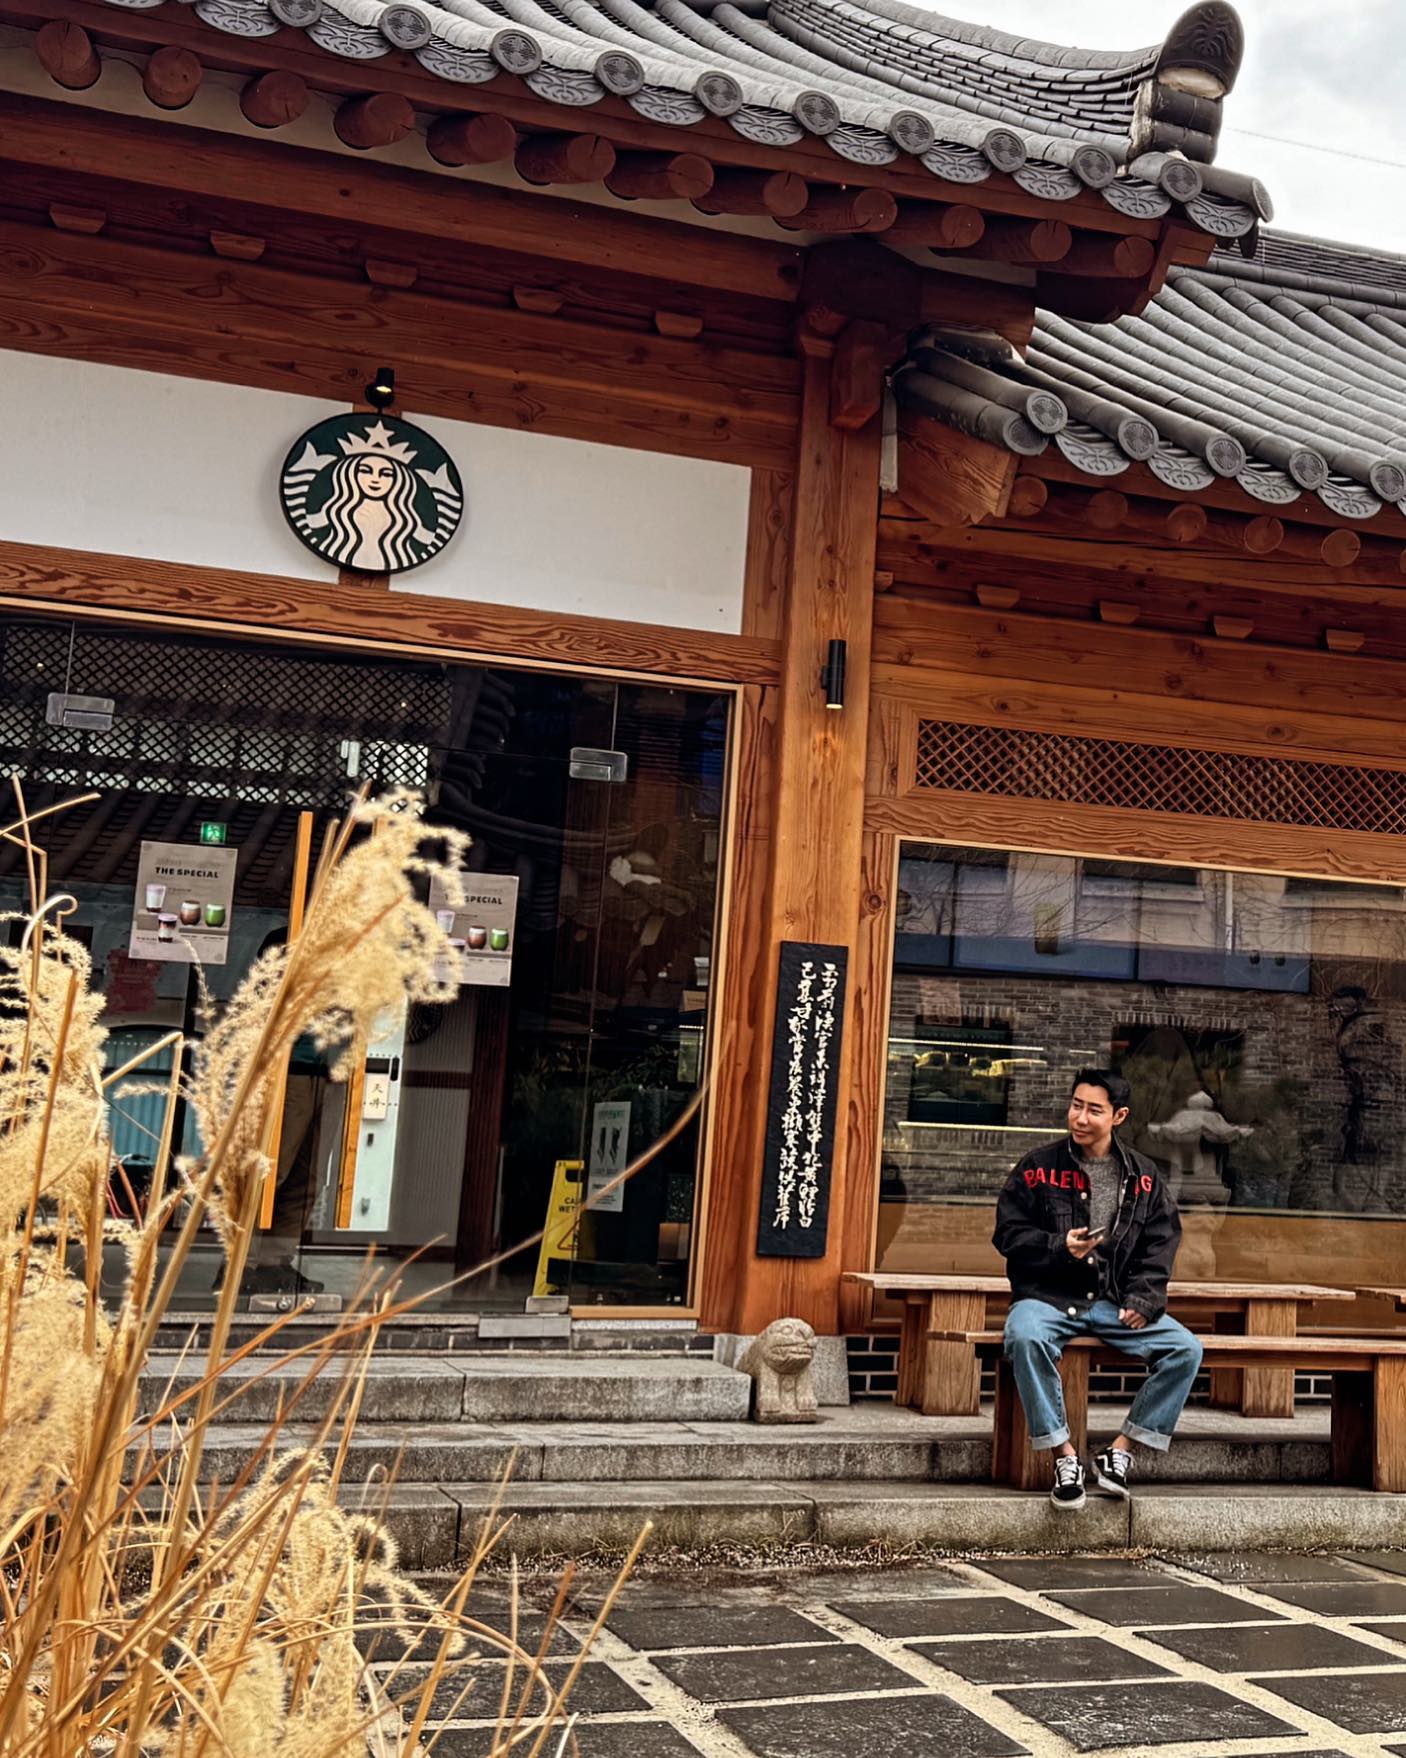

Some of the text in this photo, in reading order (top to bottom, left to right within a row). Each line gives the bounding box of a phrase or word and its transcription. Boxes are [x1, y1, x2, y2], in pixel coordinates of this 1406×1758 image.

[155, 867, 219, 878] THE SPECIAL
[464, 896, 503, 904] SPECIAL
